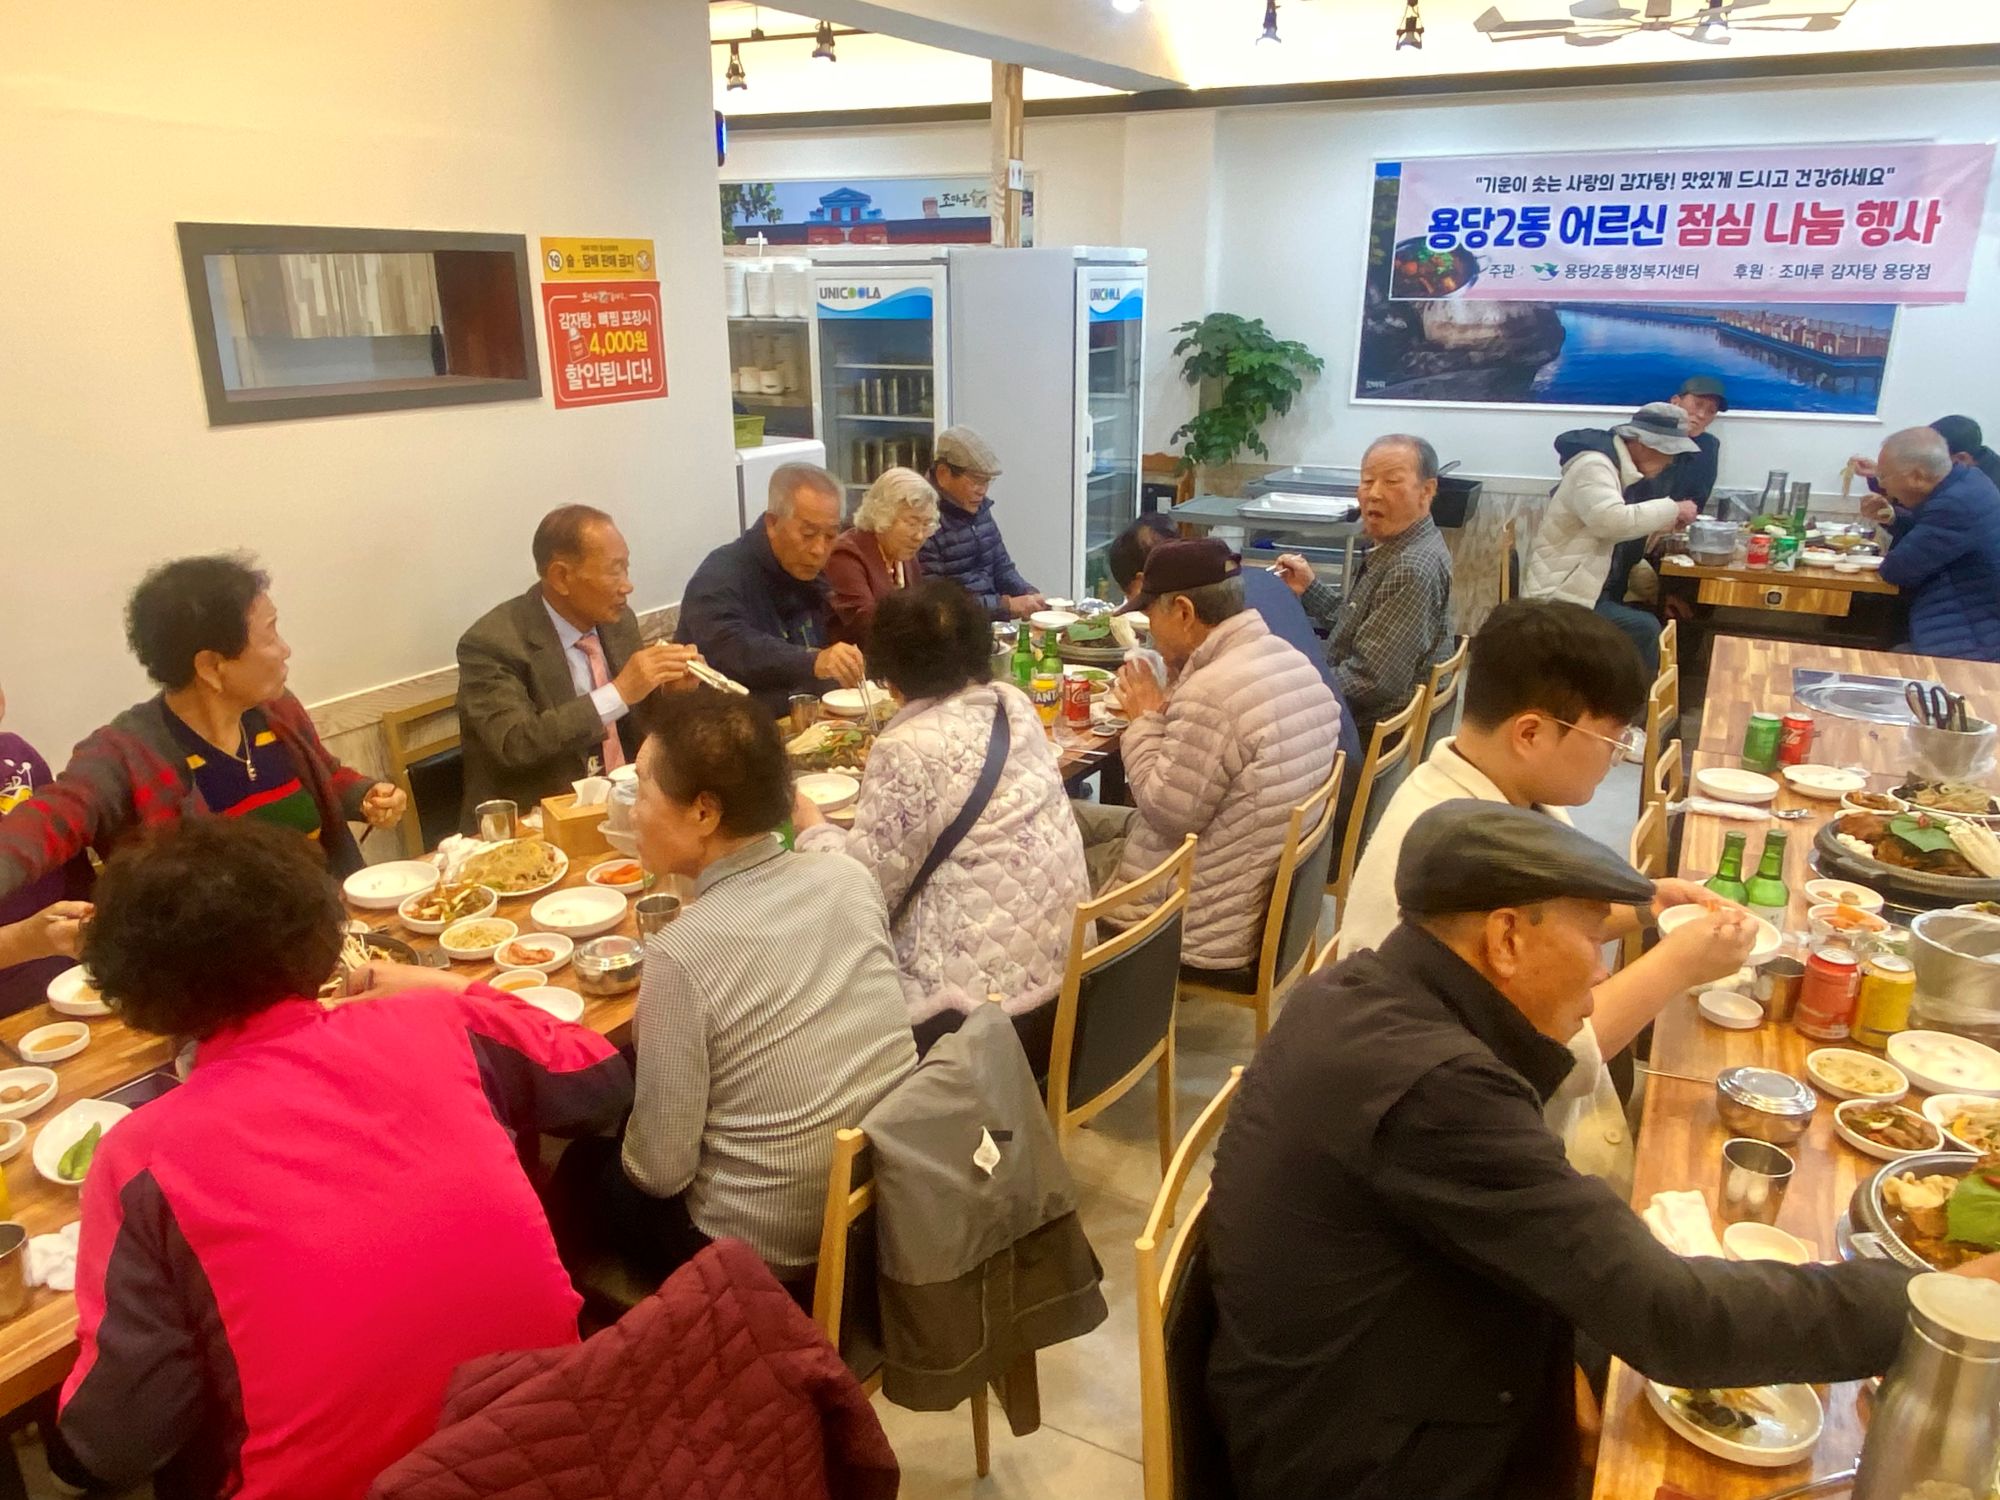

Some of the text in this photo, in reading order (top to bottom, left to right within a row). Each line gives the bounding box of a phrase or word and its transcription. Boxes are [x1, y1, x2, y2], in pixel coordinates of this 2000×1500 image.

[1475, 166, 1897, 194] "기운이 솟는 사랑의 감자탕! 맛있게 드시고 건강하세요"
[1428, 199, 1943, 249] 용당2동 어르신 점심 나눔 행사
[1488, 263, 1516, 279] 주관
[1564, 262, 1700, 280] 용당2동행정복지센터
[1732, 263, 1764, 280] 후원
[1778, 263, 1825, 280] 조마루
[1830, 263, 1878, 280] 감자탕
[1882, 262, 1932, 280] 용당점
[819, 286, 882, 300] UNICOOLA
[621, 309, 652, 326] 포장시
[590, 331, 648, 356] 4,000원
[565, 358, 653, 390] 할인됩니다!
